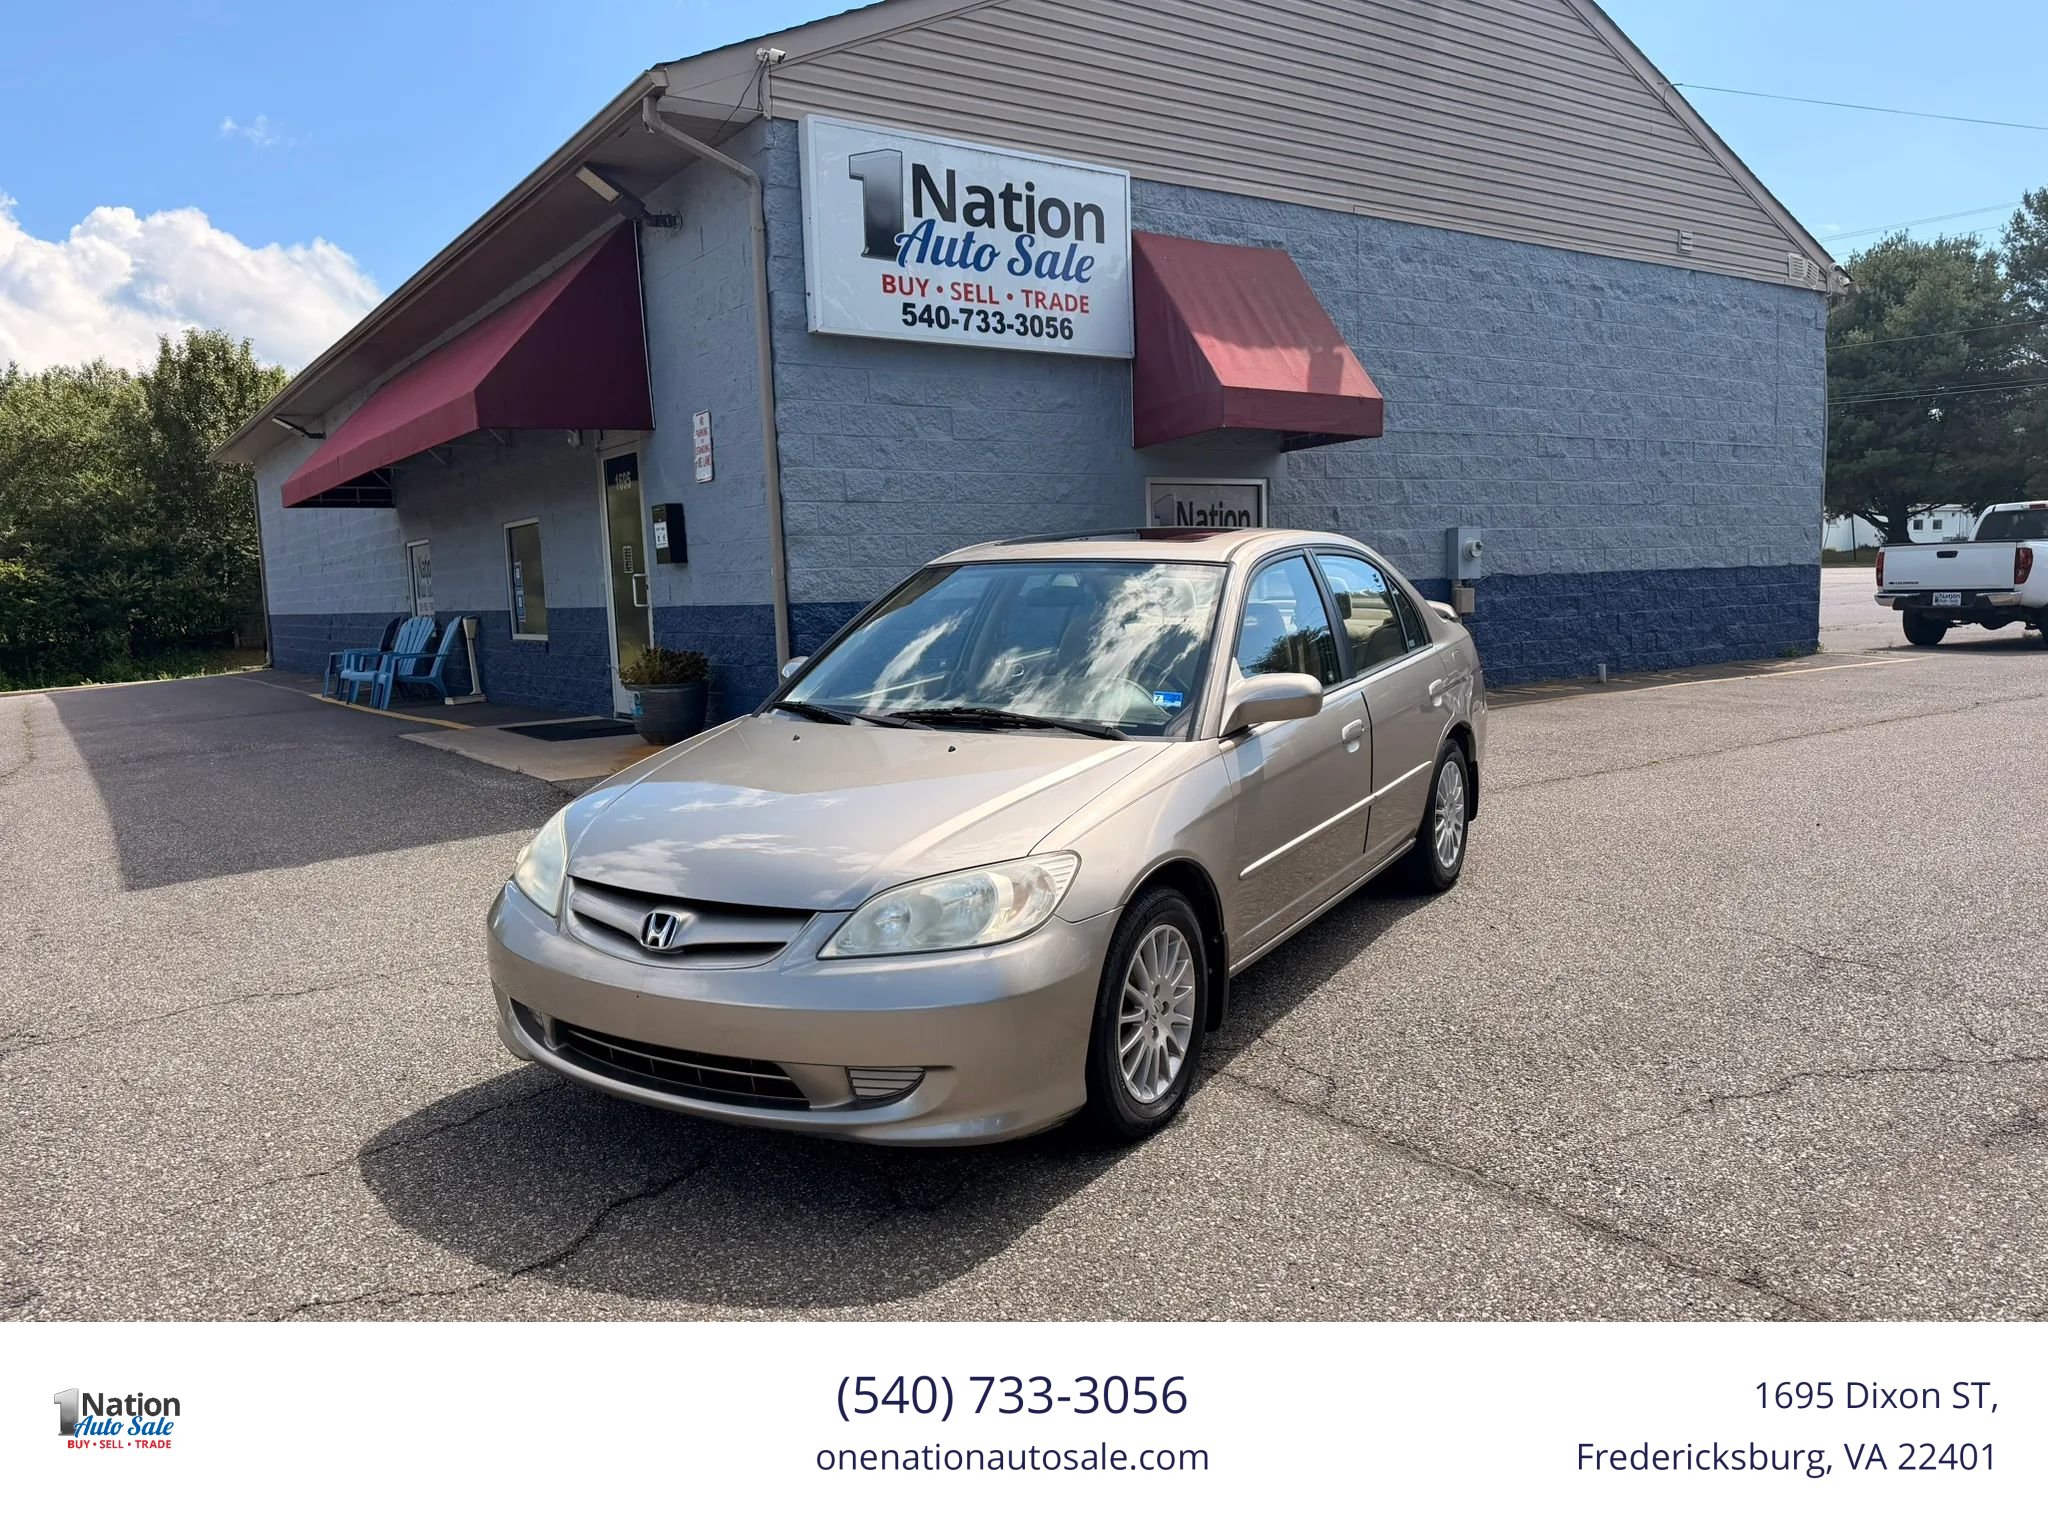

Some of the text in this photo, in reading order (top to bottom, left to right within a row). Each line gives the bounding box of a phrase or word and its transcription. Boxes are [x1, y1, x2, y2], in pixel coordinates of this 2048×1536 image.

[849, 149, 1105, 261] 1 Nation
[895, 219, 1095, 283] Auto Sale
[882, 274, 1090, 314] BUY SELL TRADE
[902, 303, 1074, 340] 540-733-3056
[1177, 501, 1251, 527] Nation
